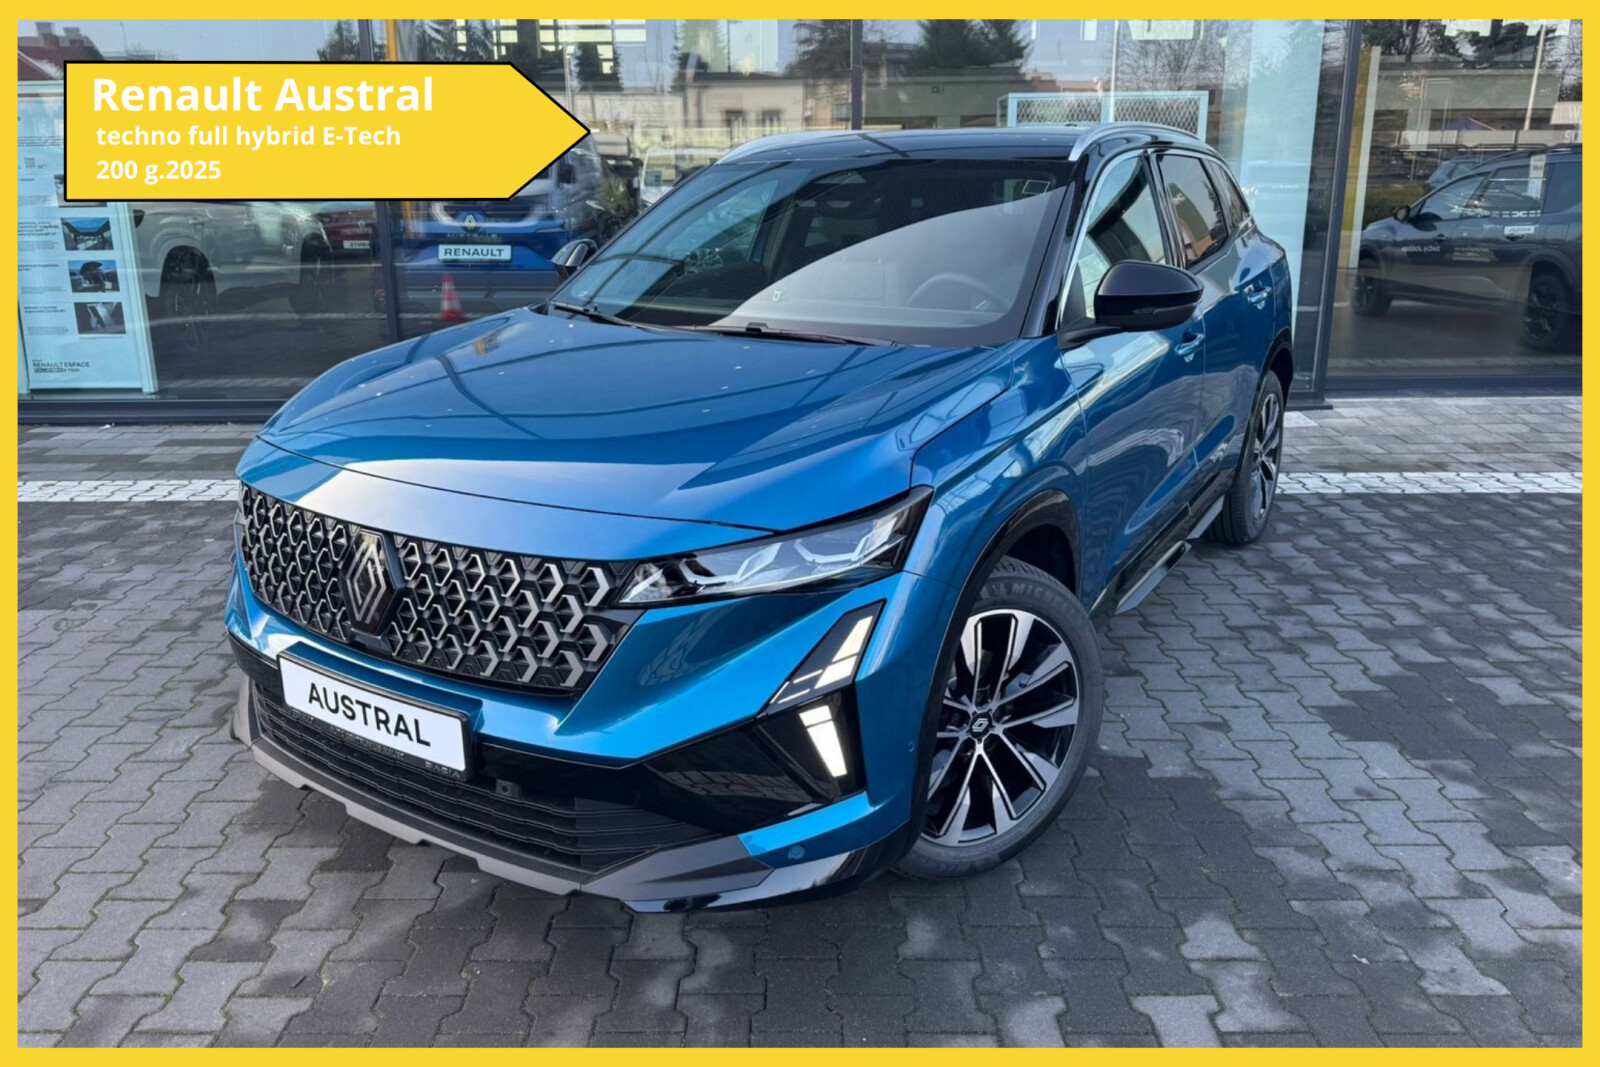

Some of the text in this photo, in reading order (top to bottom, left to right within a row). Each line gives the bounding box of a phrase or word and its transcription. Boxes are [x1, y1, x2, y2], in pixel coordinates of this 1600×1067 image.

[444, 248, 505, 257] RENAULT
[307, 682, 431, 747] AUSTRAL
[425, 761, 460, 779] DACIA
